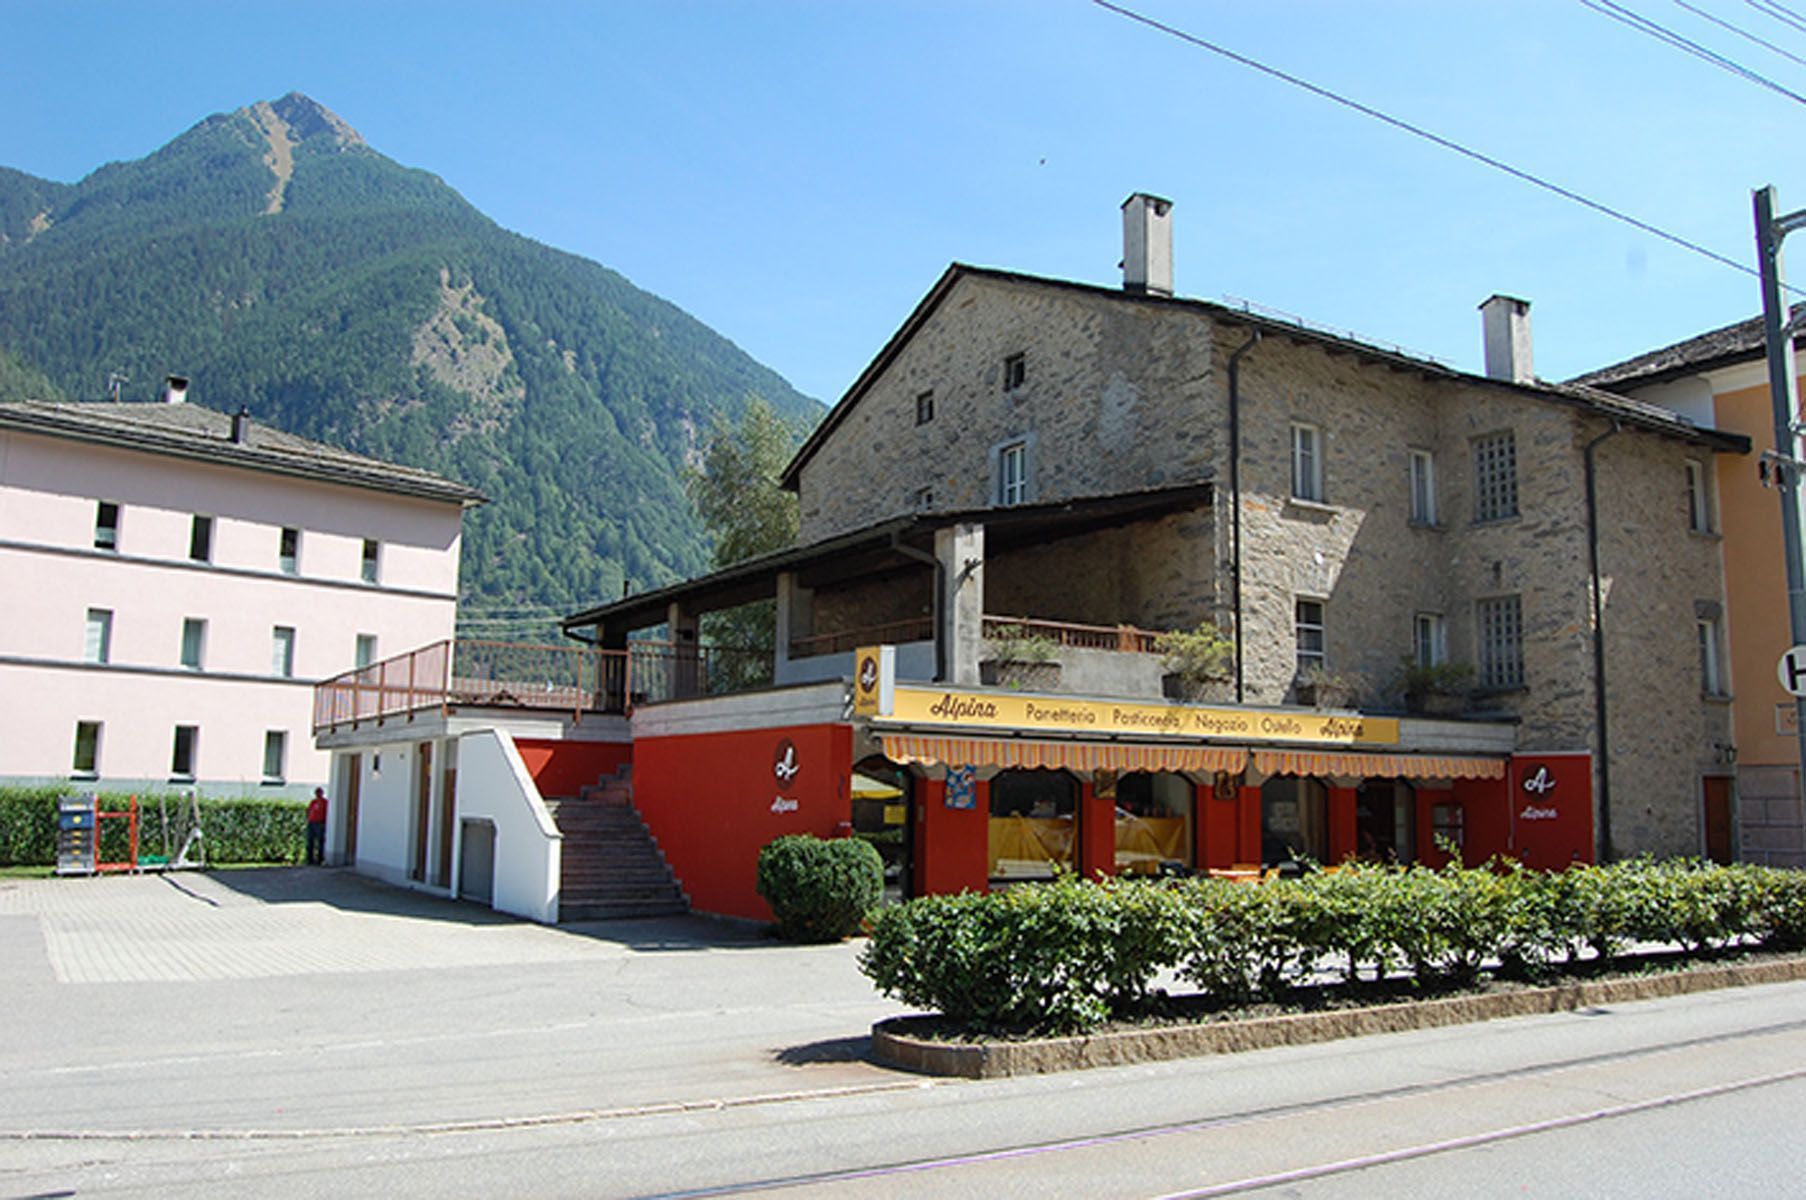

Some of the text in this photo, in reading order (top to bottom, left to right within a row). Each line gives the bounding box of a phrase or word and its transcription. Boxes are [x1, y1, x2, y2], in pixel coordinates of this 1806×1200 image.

[929, 693, 998, 720] Alpina
[1026, 703, 1096, 724] Panetteria
[1194, 713, 1249, 734] Negozio
[1319, 717, 1365, 739] Alpina
